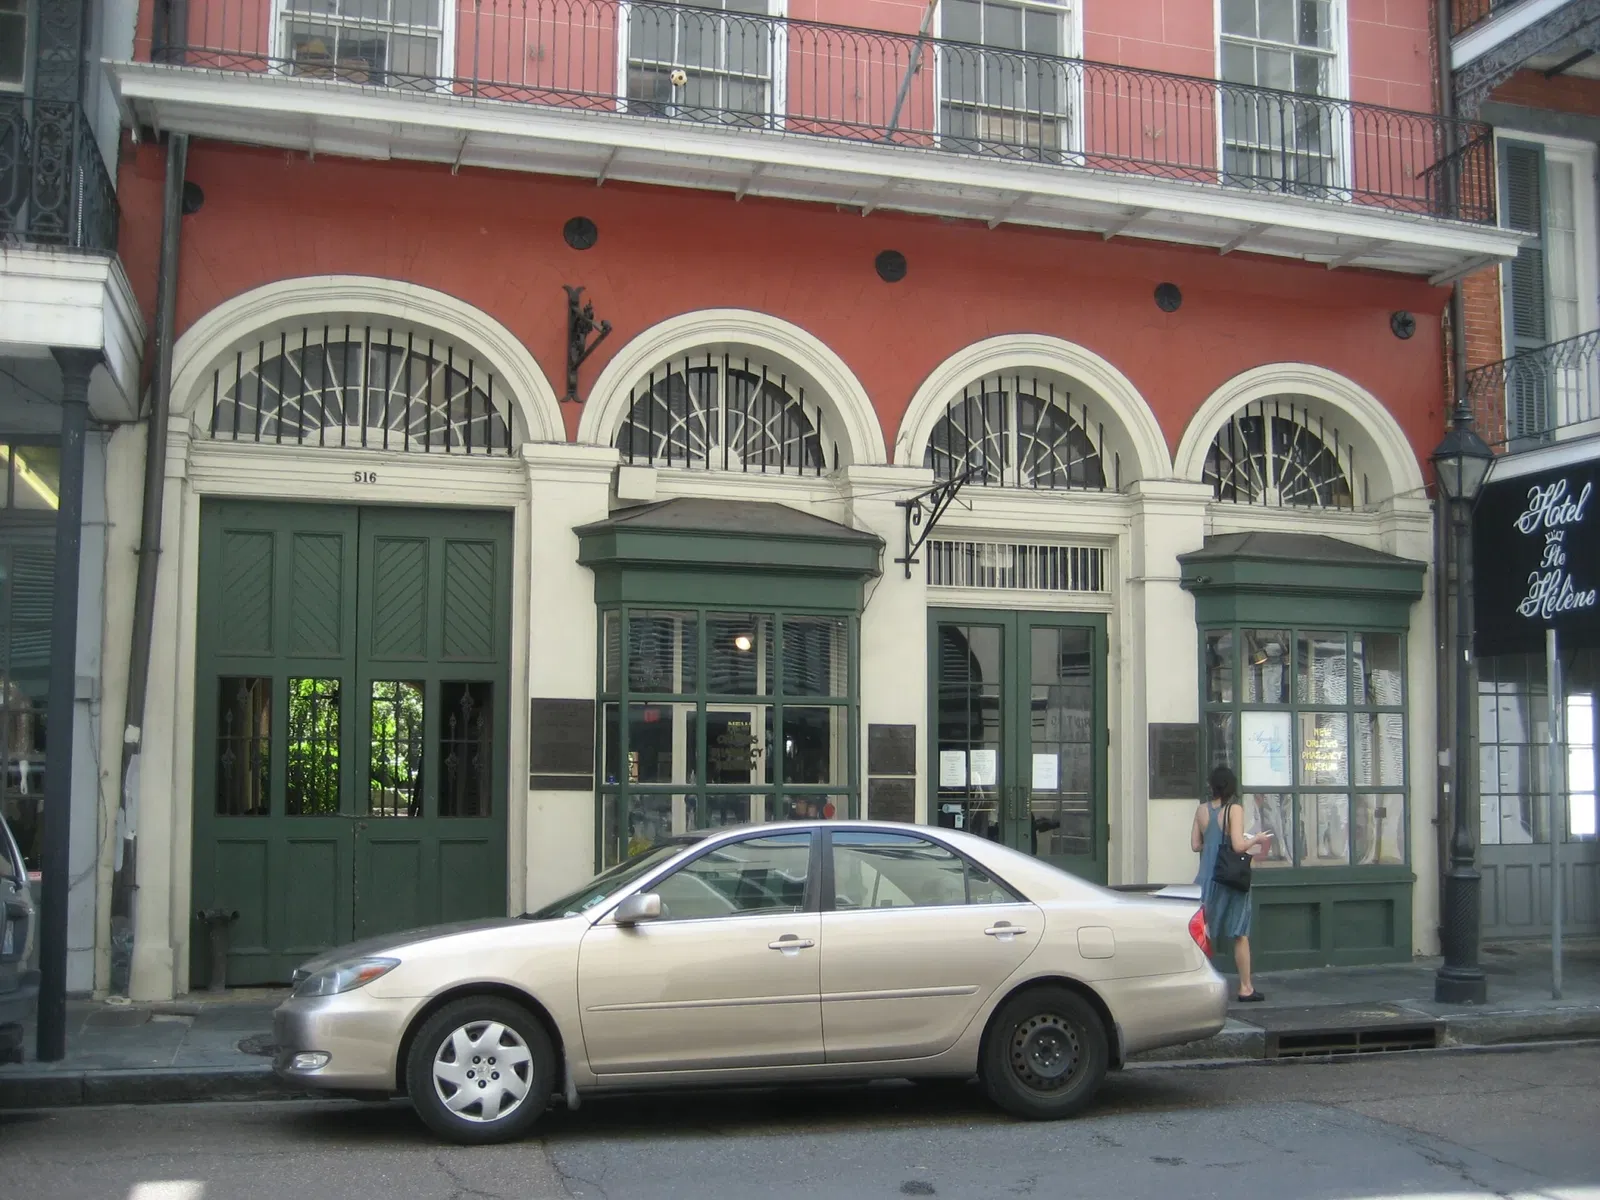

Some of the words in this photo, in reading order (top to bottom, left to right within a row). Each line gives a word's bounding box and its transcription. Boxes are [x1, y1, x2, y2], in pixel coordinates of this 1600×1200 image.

[354, 471, 377, 483] 516
[1513, 478, 1592, 534] Hotel
[1540, 544, 1566, 568] Ste
[1516, 568, 1596, 619] Hélène
